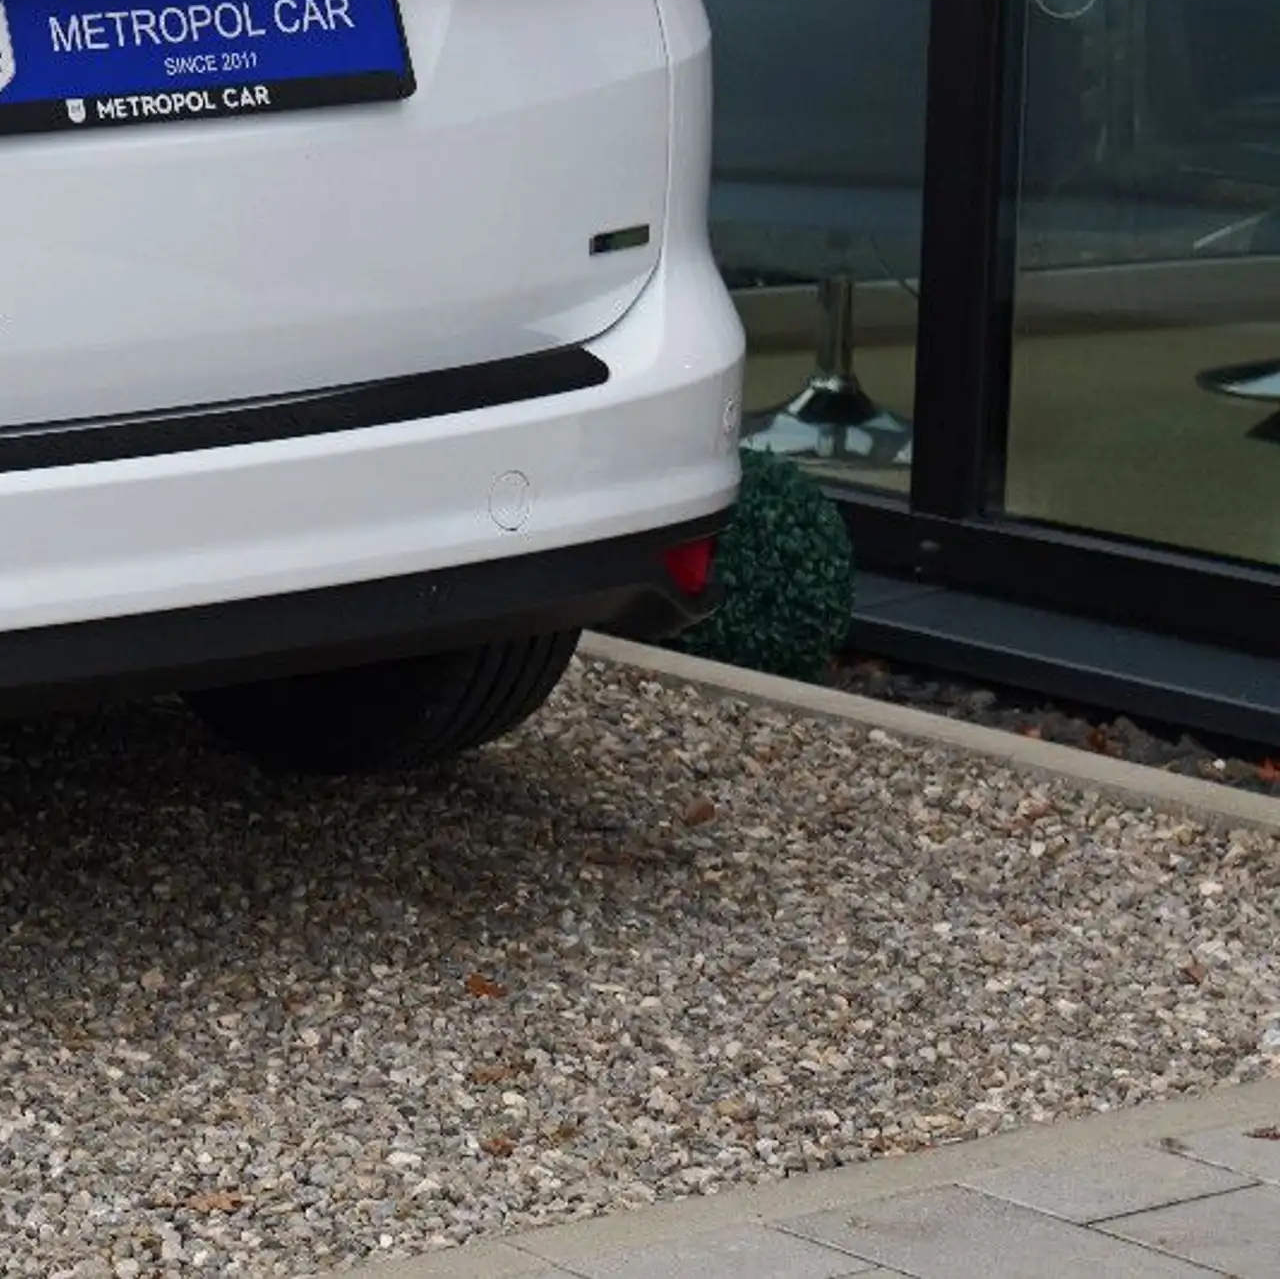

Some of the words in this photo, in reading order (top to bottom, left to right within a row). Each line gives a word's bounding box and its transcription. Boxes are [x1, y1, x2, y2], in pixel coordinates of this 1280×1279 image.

[48, 0, 266, 54] METROPOL
[164, 54, 220, 77] SINCE
[221, 52, 259, 74] 2011
[96, 89, 217, 122] METROPOL
[222, 85, 271, 108] CAR
